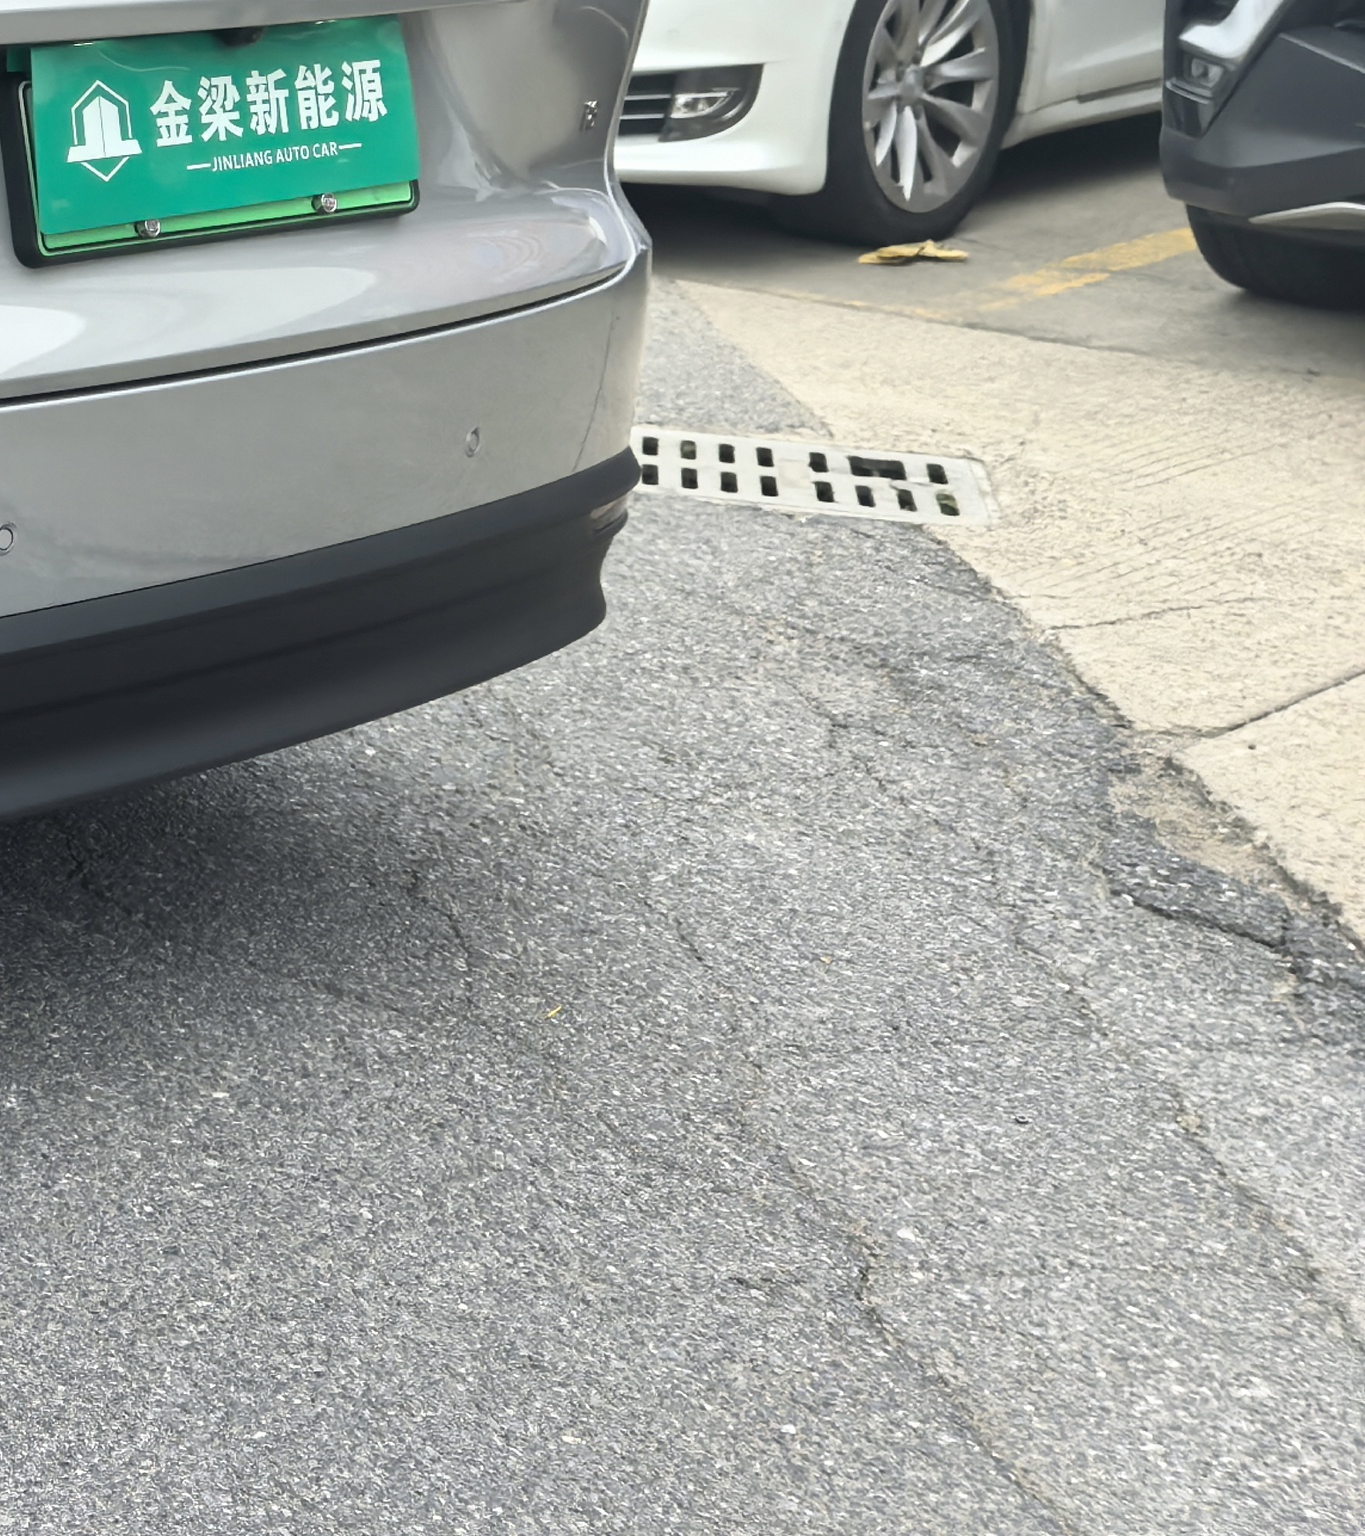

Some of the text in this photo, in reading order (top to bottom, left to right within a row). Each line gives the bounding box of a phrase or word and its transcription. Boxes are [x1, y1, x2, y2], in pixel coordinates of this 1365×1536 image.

[149, 59, 388, 148] 金梁新能源
[212, 141, 339, 171] JINLIANG AUTO CAR
